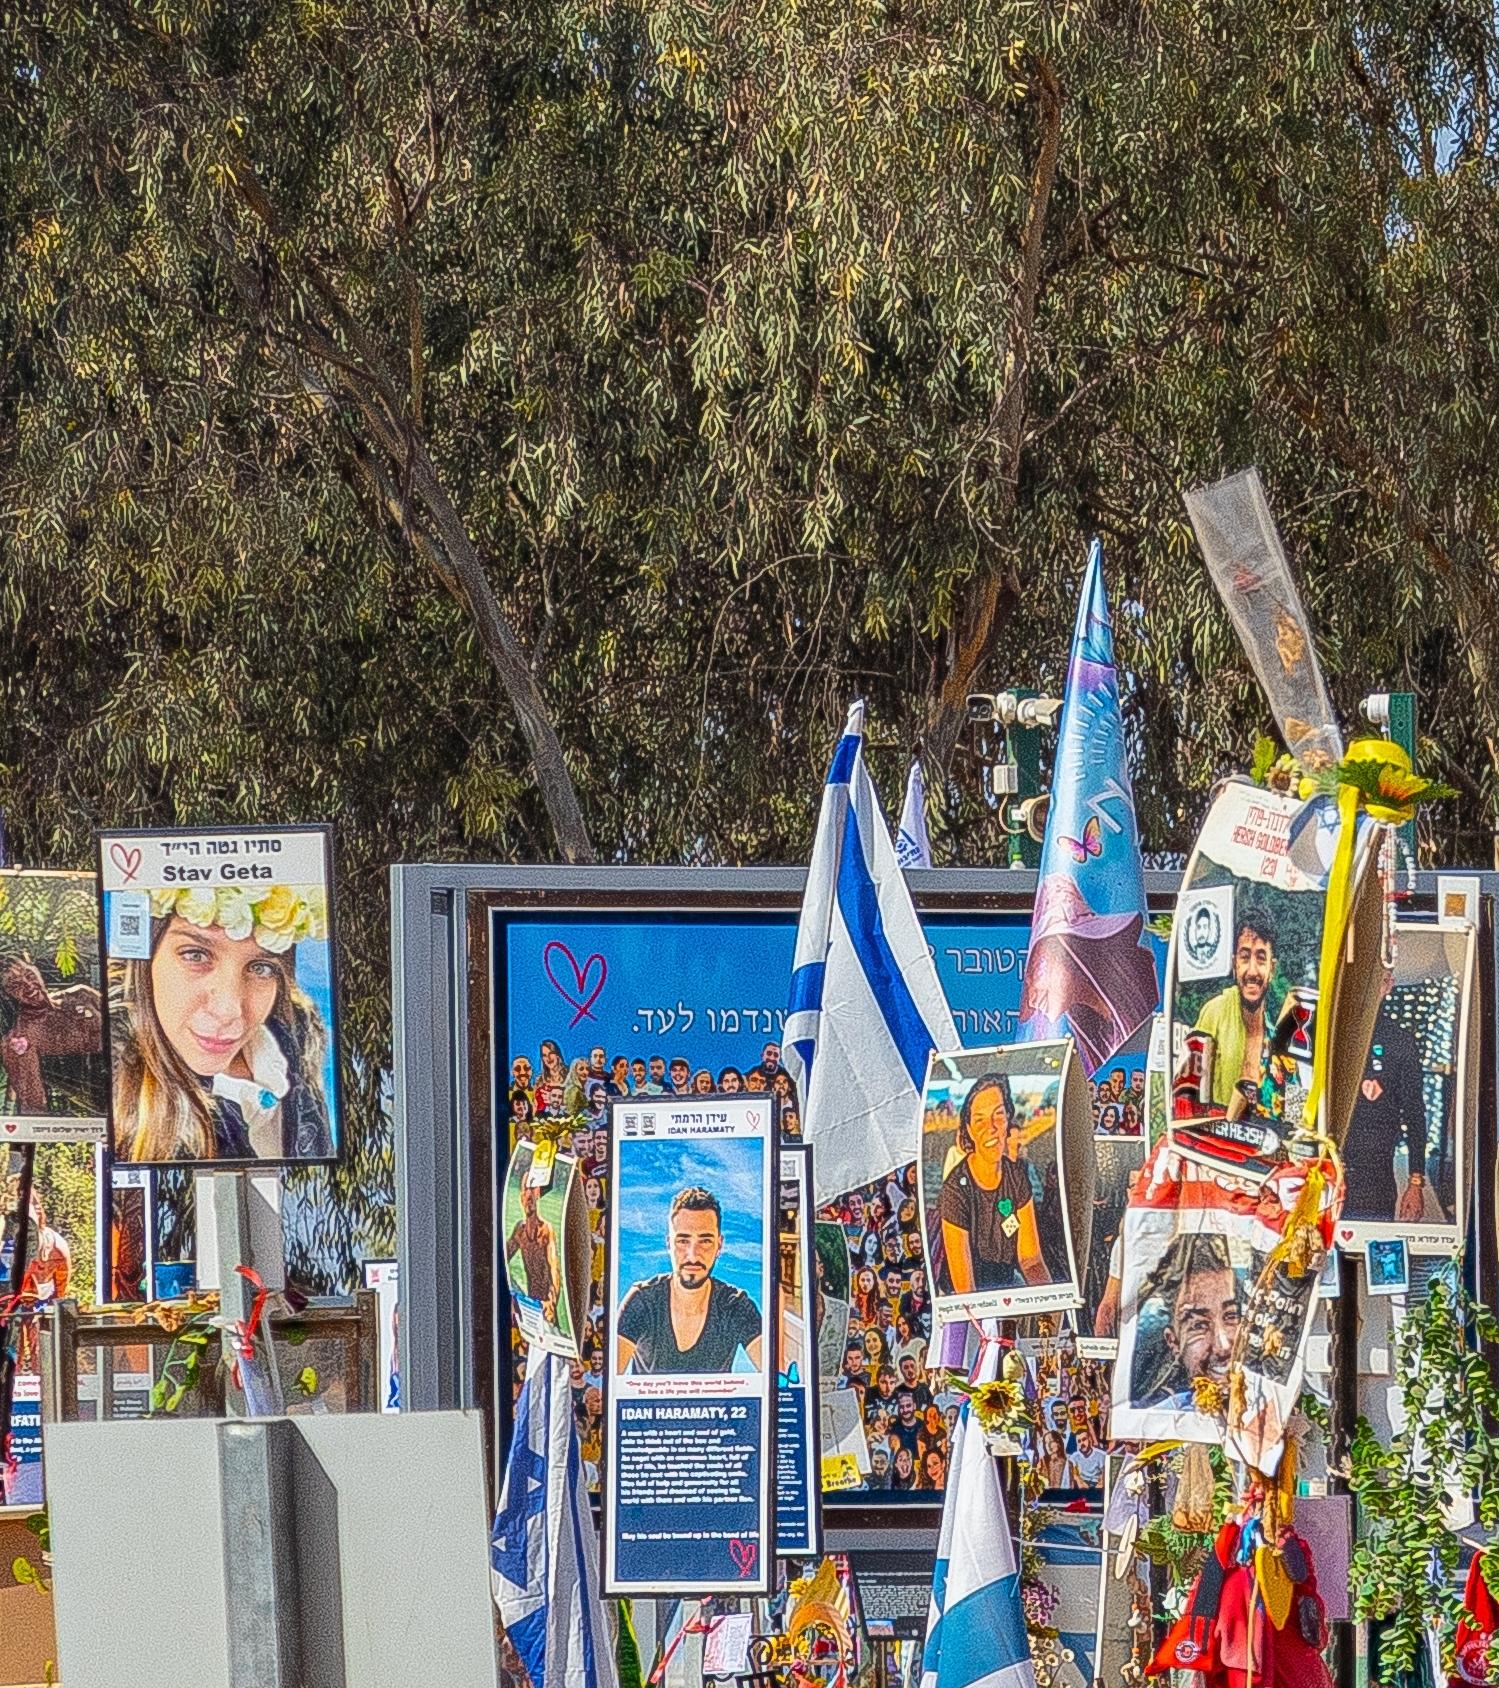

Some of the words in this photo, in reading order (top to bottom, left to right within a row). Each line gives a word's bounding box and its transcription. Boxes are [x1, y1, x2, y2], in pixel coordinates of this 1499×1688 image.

[206, 841, 238, 854] גטה
[245, 839, 281, 853] סתיו
[163, 865, 212, 882] Stav
[220, 863, 273, 880] Geta
[946, 949, 1029, 981] קטובר
[671, 1114, 701, 1124] הרמתי
[705, 1114, 727, 1124] עידן
[622, 1408, 652, 1420] IDAN
[656, 1407, 728, 1421] HARAMATY,
[731, 1407, 747, 1418] 22
